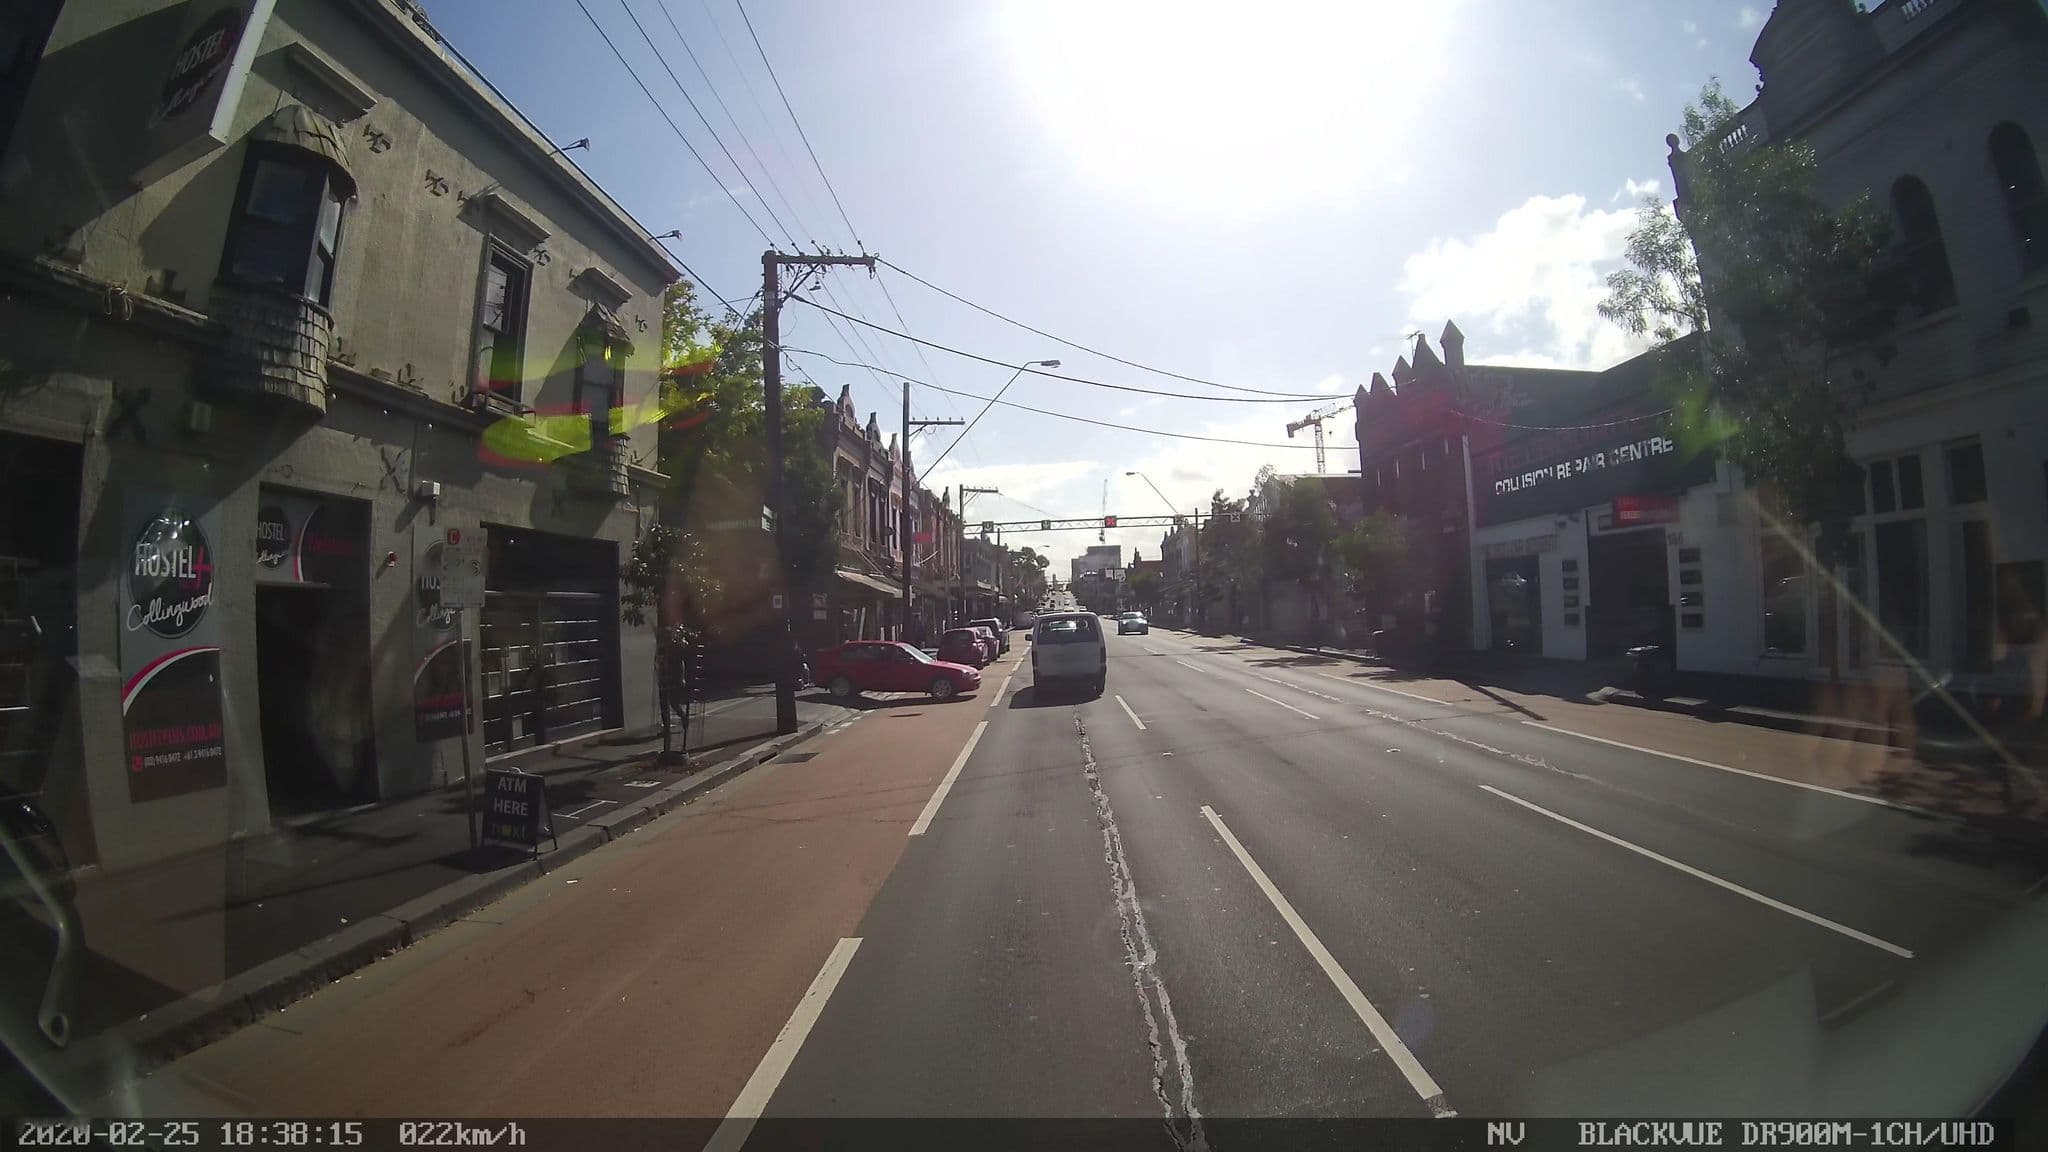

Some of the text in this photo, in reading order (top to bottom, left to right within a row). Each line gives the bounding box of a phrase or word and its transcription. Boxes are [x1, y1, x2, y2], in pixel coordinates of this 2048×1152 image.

[1608, 436, 1674, 465] CENTRE
[127, 582, 213, 631] Collingwood
[498, 775, 527, 793] ATM
[493, 797, 529, 816] HERE
